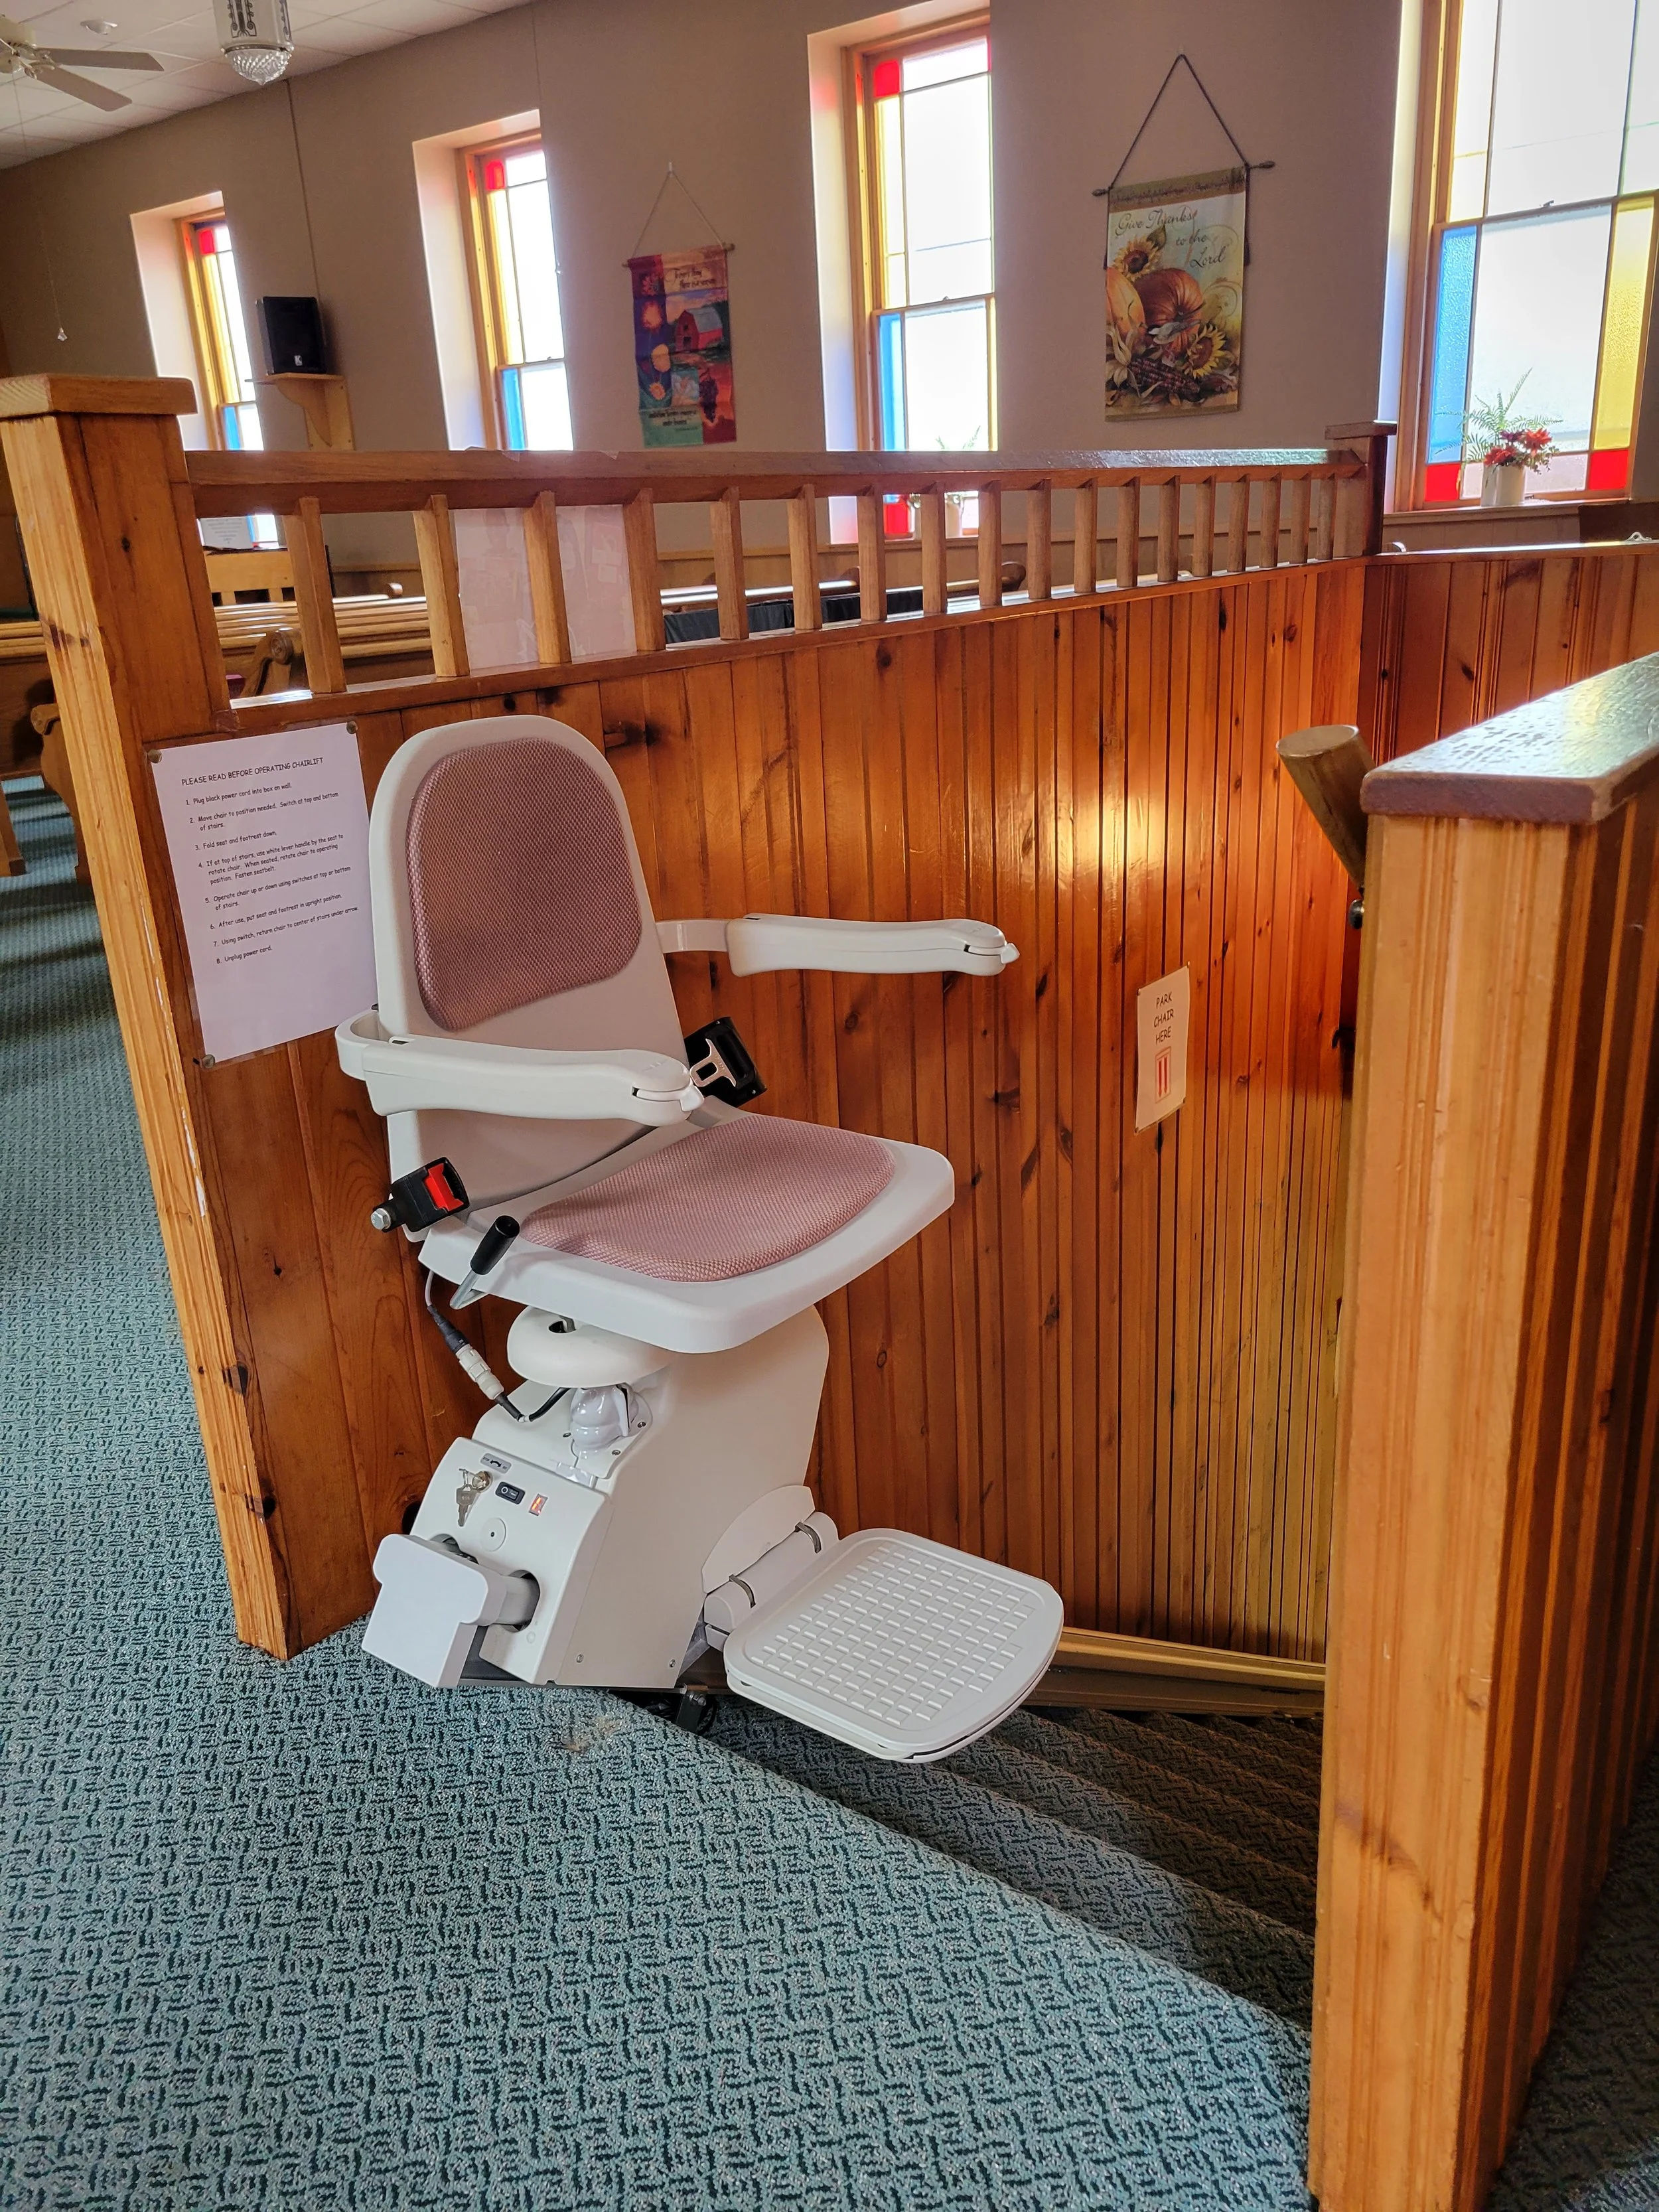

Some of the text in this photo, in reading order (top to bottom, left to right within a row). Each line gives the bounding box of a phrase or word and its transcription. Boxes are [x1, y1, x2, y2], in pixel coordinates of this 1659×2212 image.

[1114, 206, 1193, 236] Give Thanks
[1176, 228, 1206, 246] to the
[1190, 246, 1226, 268] Lord
[182, 776, 207, 786] PLEASE
[228, 769, 252, 778] BEFORE
[255, 763, 291, 774] OPERATING
[292, 757, 323, 768] CHAIRLIFT
[240, 833, 261, 842] footrest
[317, 844, 338, 853] operating
[292, 875, 312, 884] switches
[279, 904, 298, 913] footrest
[305, 899, 321, 907] upright
[243, 950, 258, 958] power
[1156, 992, 1173, 1009] PARK
[1153, 1008, 1174, 1028] CHAIR
[1155, 1026, 1171, 1045] HERE
